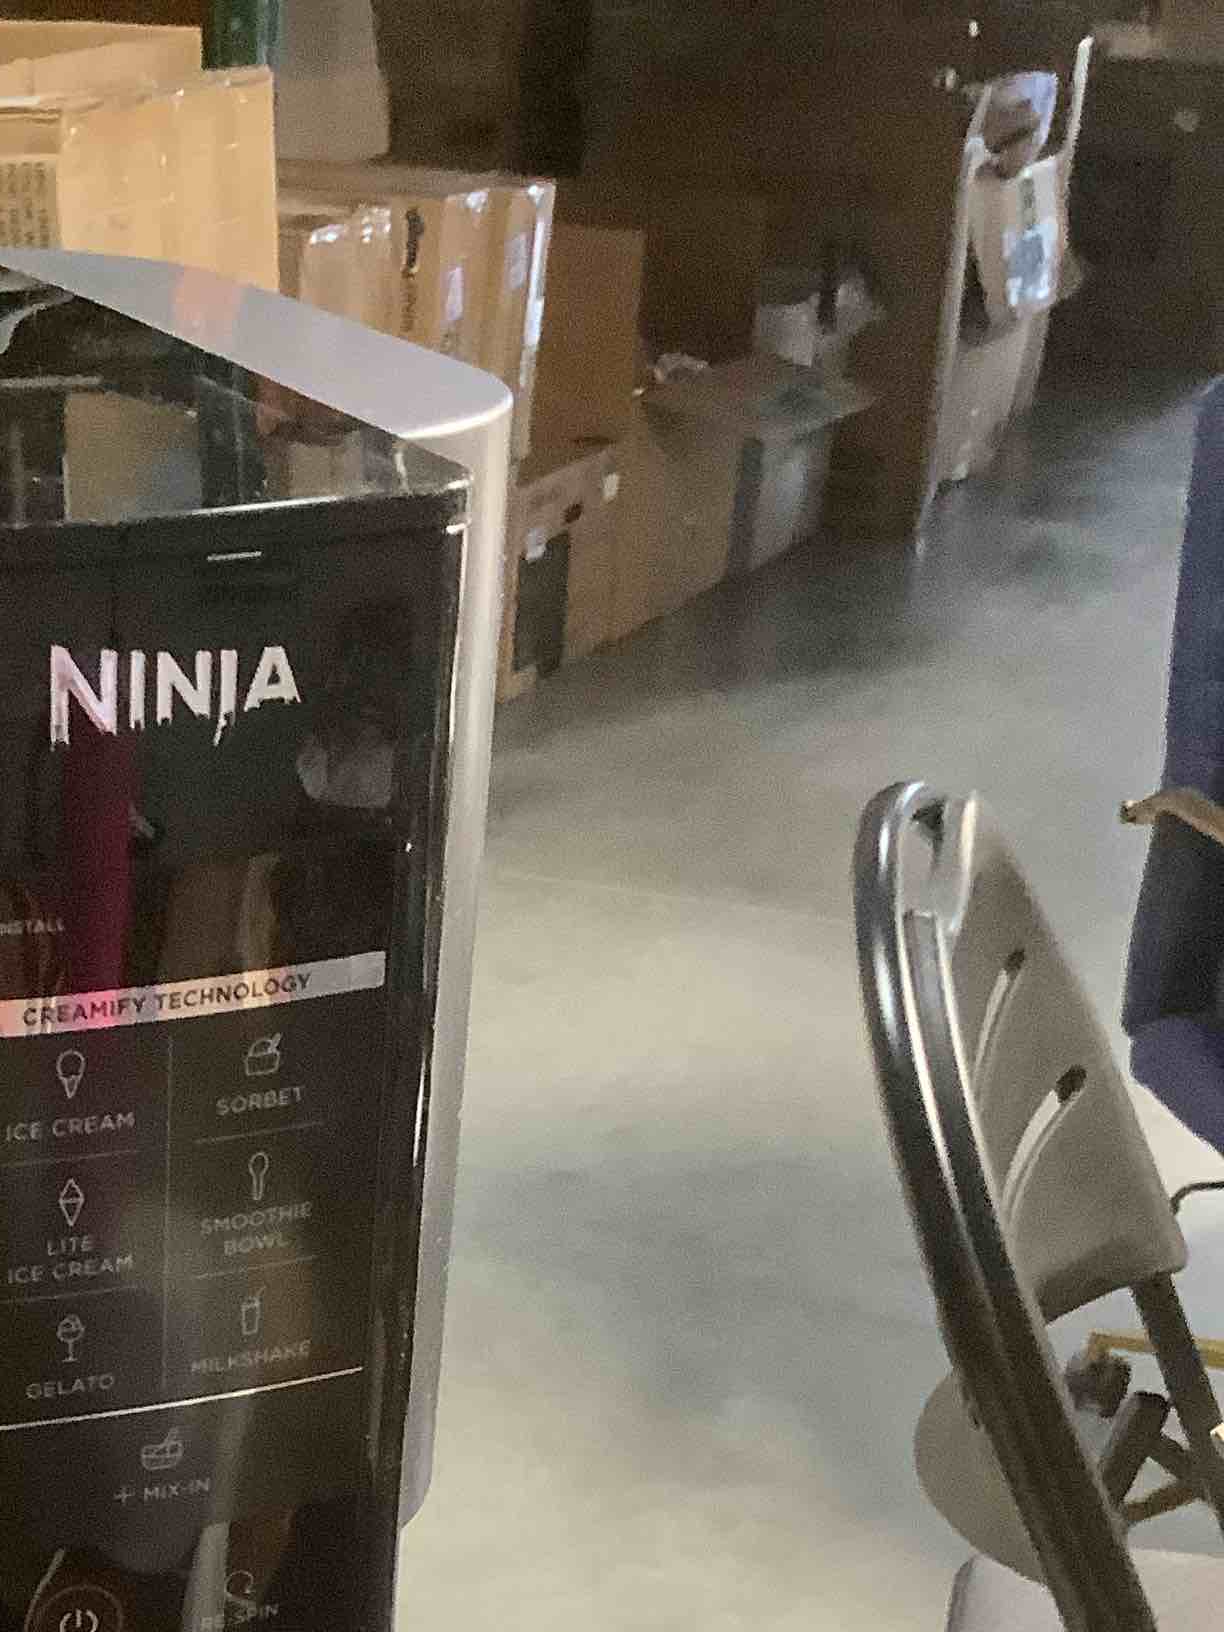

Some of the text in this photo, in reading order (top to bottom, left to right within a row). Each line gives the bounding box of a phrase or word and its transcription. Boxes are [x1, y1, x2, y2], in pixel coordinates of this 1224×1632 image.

[50, 645, 301, 748] NINJA
[23, 974, 312, 1027] CREAMIFY TECHNOLOGY
[216, 1086, 304, 1116] SORBET
[5, 1112, 136, 1142] ICE CREAM
[47, 1237, 94, 1256] LITE
[7, 1254, 134, 1285] ICE CREAM
[191, 1341, 312, 1373] MILKSHAKE
[26, 1374, 115, 1401] GELATO
